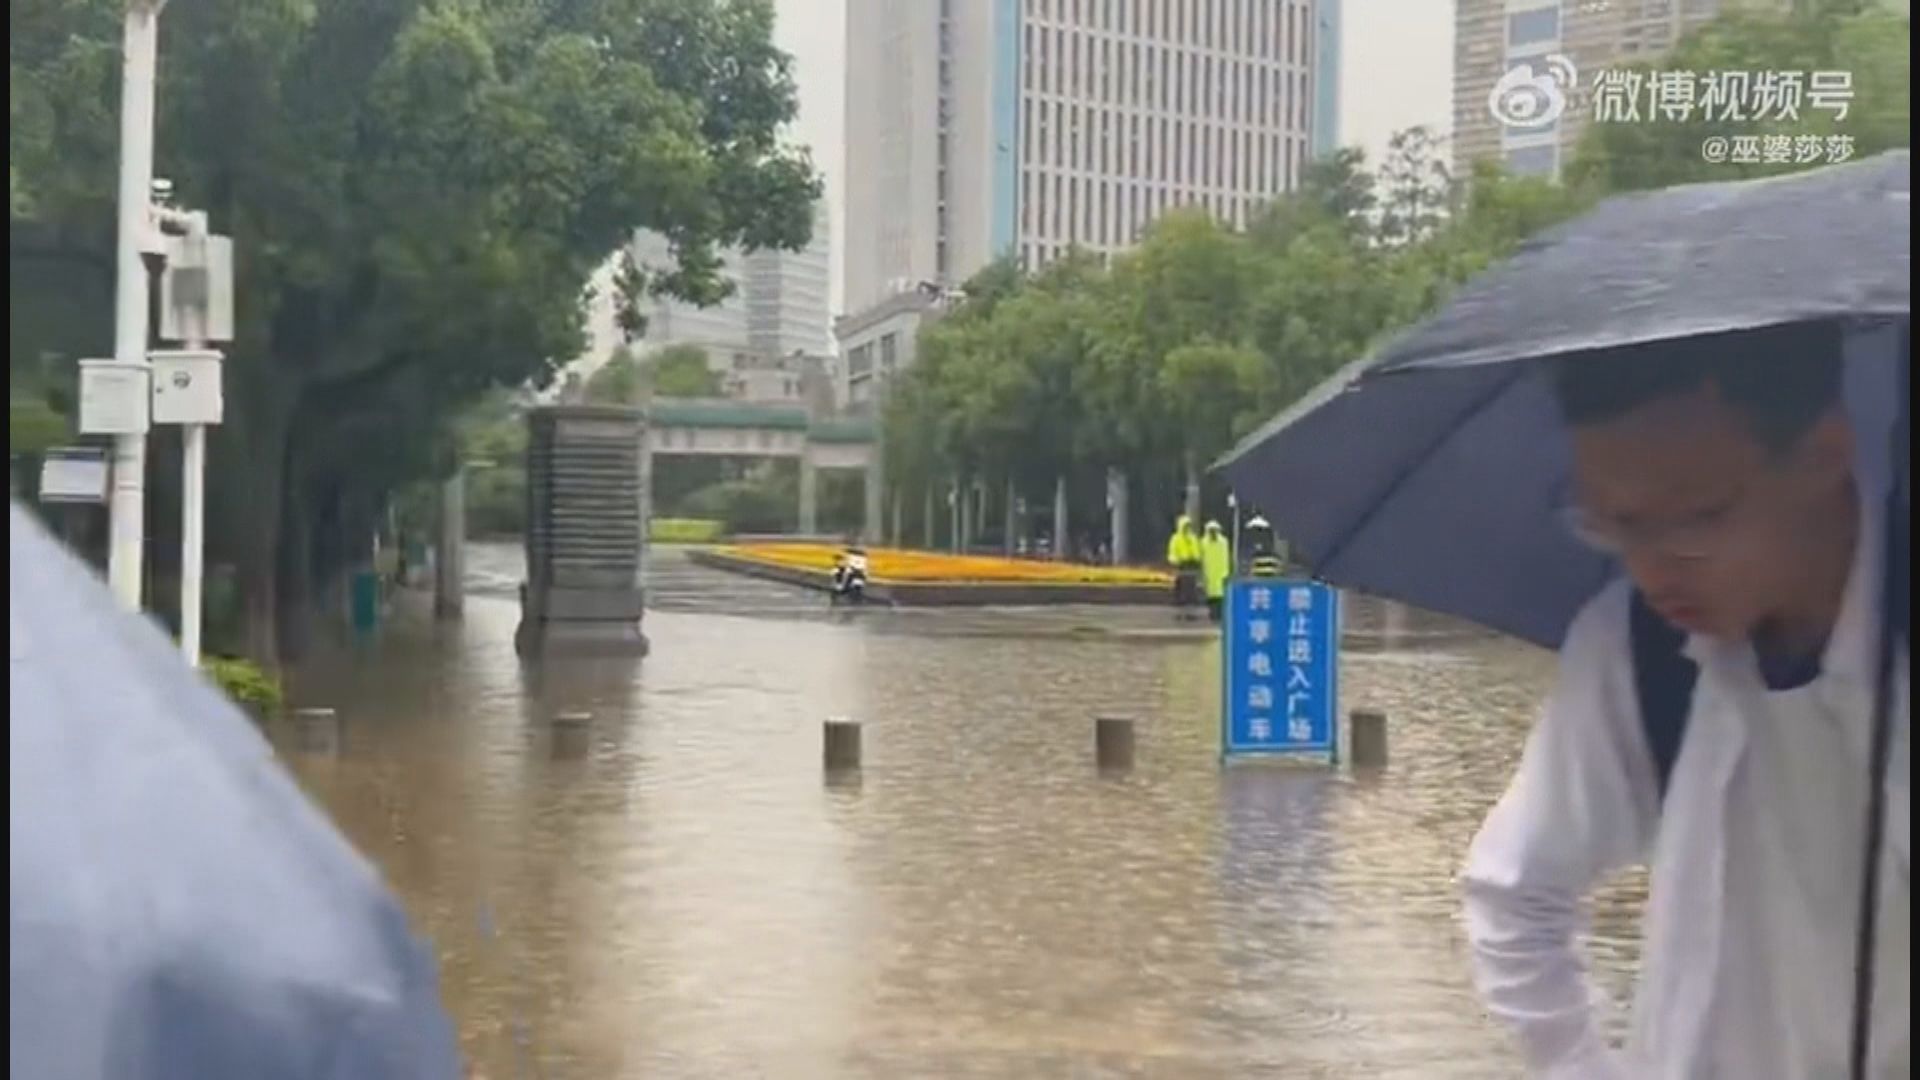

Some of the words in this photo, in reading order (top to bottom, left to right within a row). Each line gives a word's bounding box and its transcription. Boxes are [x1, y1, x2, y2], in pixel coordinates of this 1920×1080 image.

[1248, 587, 1272, 740] 共享电动车
[1287, 587, 1312, 740] 禁止进入广场
